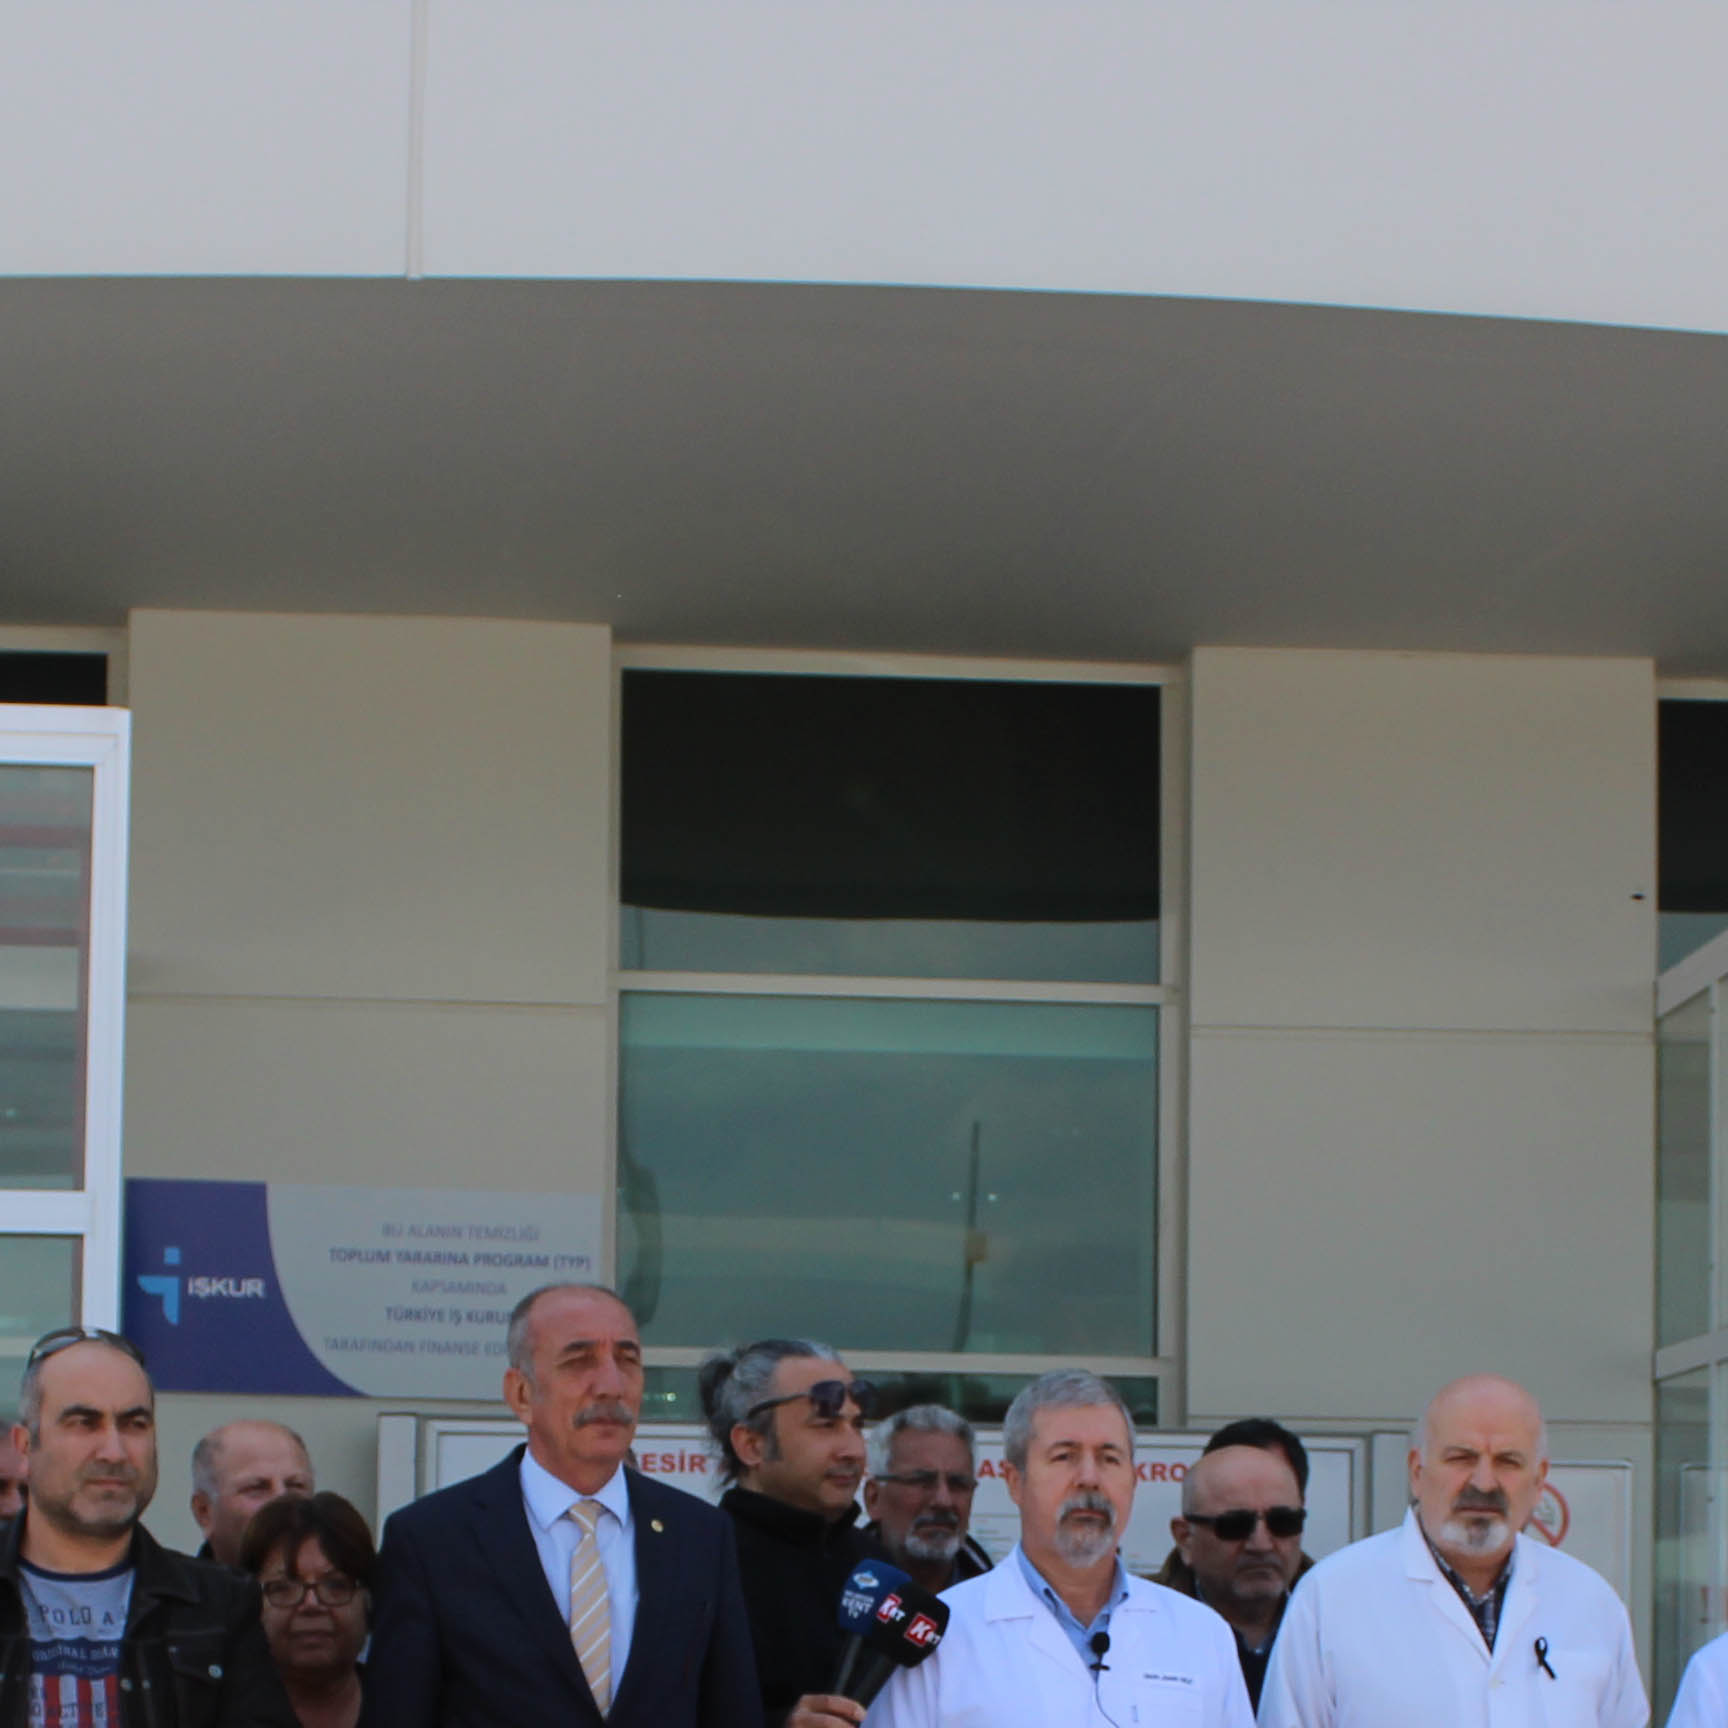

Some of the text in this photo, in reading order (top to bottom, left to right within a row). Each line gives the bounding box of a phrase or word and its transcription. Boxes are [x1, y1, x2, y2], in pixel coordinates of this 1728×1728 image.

[329, 1249, 390, 1264] TOPLUM
[396, 1251, 469, 1267] YARARINA
[473, 1253, 549, 1269] PROGRAM
[412, 1279, 507, 1296] KAPSAMINDA
[384, 1305, 514, 1326] TÜRKİYE İŞ KURU
[640, 1448, 707, 1473] ESİR
[1135, 1462, 1187, 1482] KRO
